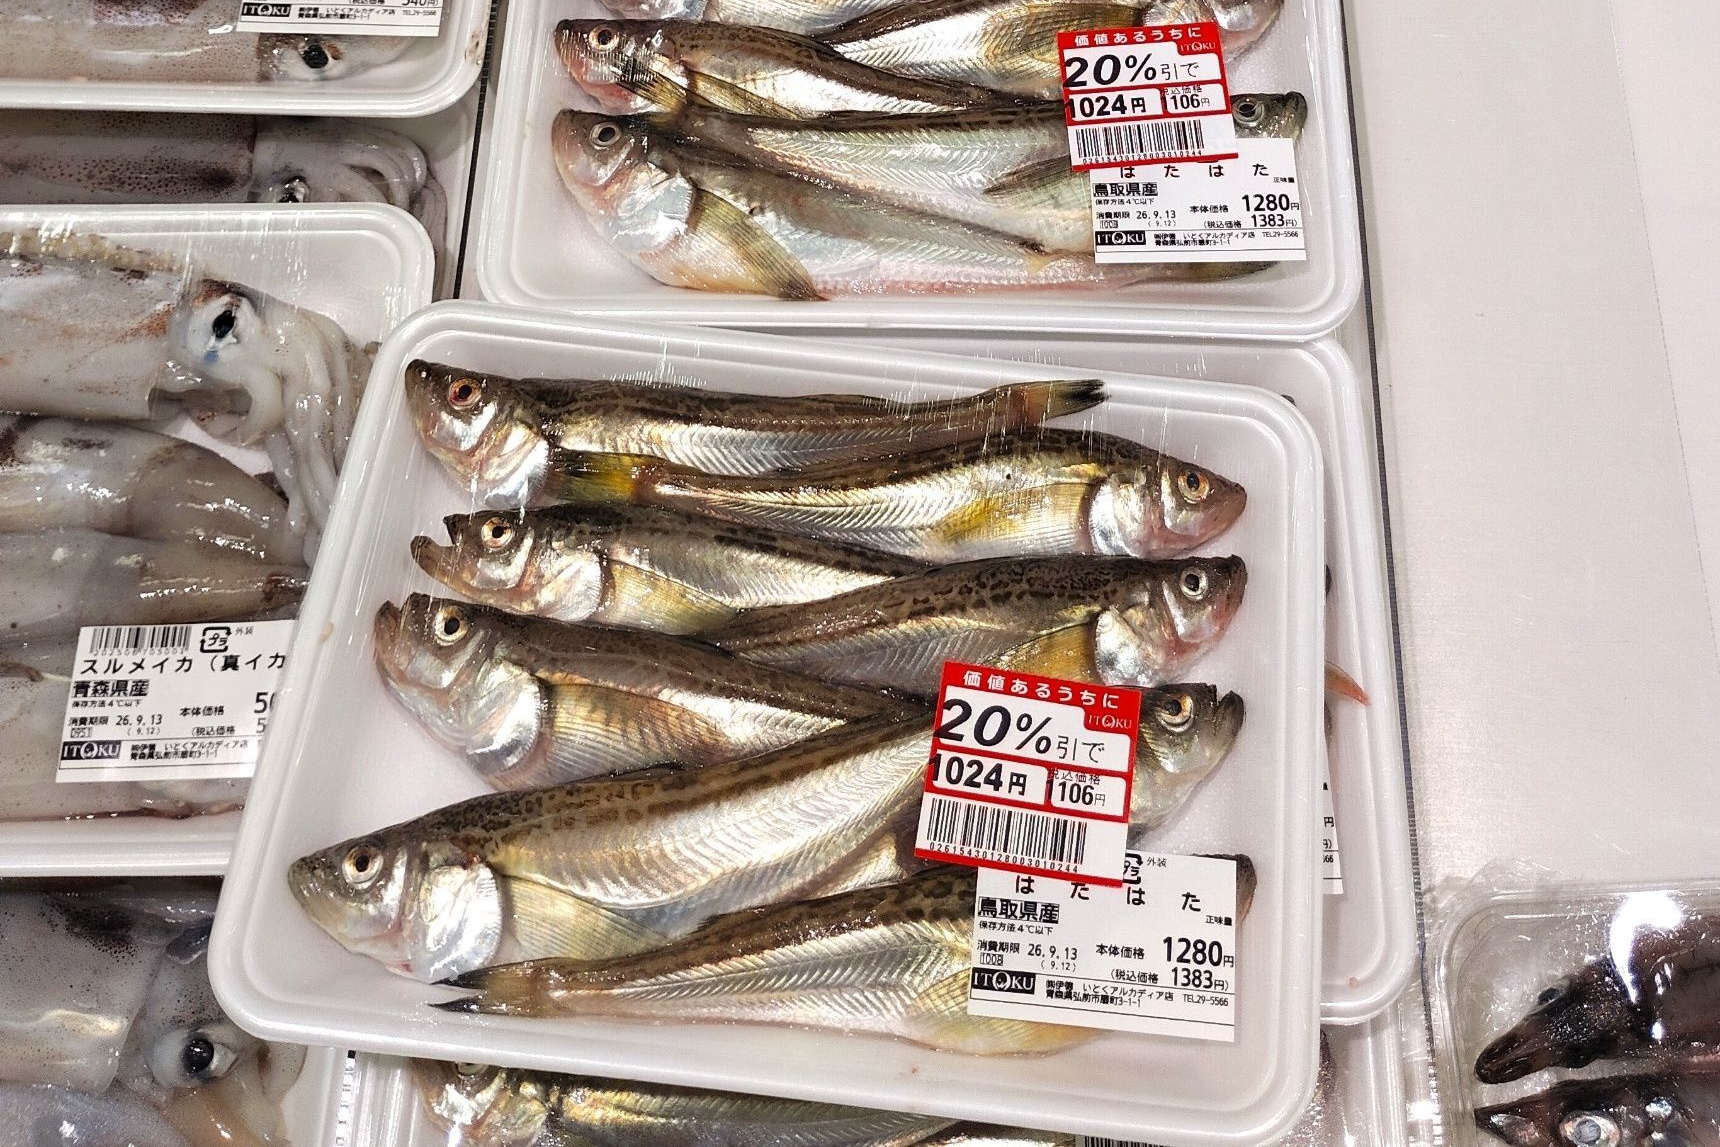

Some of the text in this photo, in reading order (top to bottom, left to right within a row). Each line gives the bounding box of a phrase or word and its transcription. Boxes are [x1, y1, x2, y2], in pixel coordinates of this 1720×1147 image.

[243, 3, 290, 17] ITOKU
[1074, 27, 1202, 46] 価値あるうちに
[1180, 41, 1216, 52] ITOKU
[1068, 94, 1146, 118] 1024円
[1094, 182, 1158, 197] 鳥取県産
[1190, 193, 1299, 213] 本体価格 1280円
[1097, 231, 1144, 245] ITOKU
[72, 679, 149, 698] 青森県産
[963, 670, 1120, 709] 価値あるうちに
[179, 705, 224, 717] 本体価格
[1088, 713, 1132, 729] ITOKU
[63, 741, 120, 759] ITOKU
[928, 752, 1028, 796] 1024円
[930, 841, 1078, 874] 02615430128003010244
[1146, 857, 1167, 868] 外装
[979, 897, 1059, 923] 鳥取県産
[1206, 914, 1233, 927] 正味量
[976, 939, 1020, 954] 消費期限
[1095, 936, 1235, 968] 本体価格 1280円
[973, 971, 1034, 991] ITOKU
